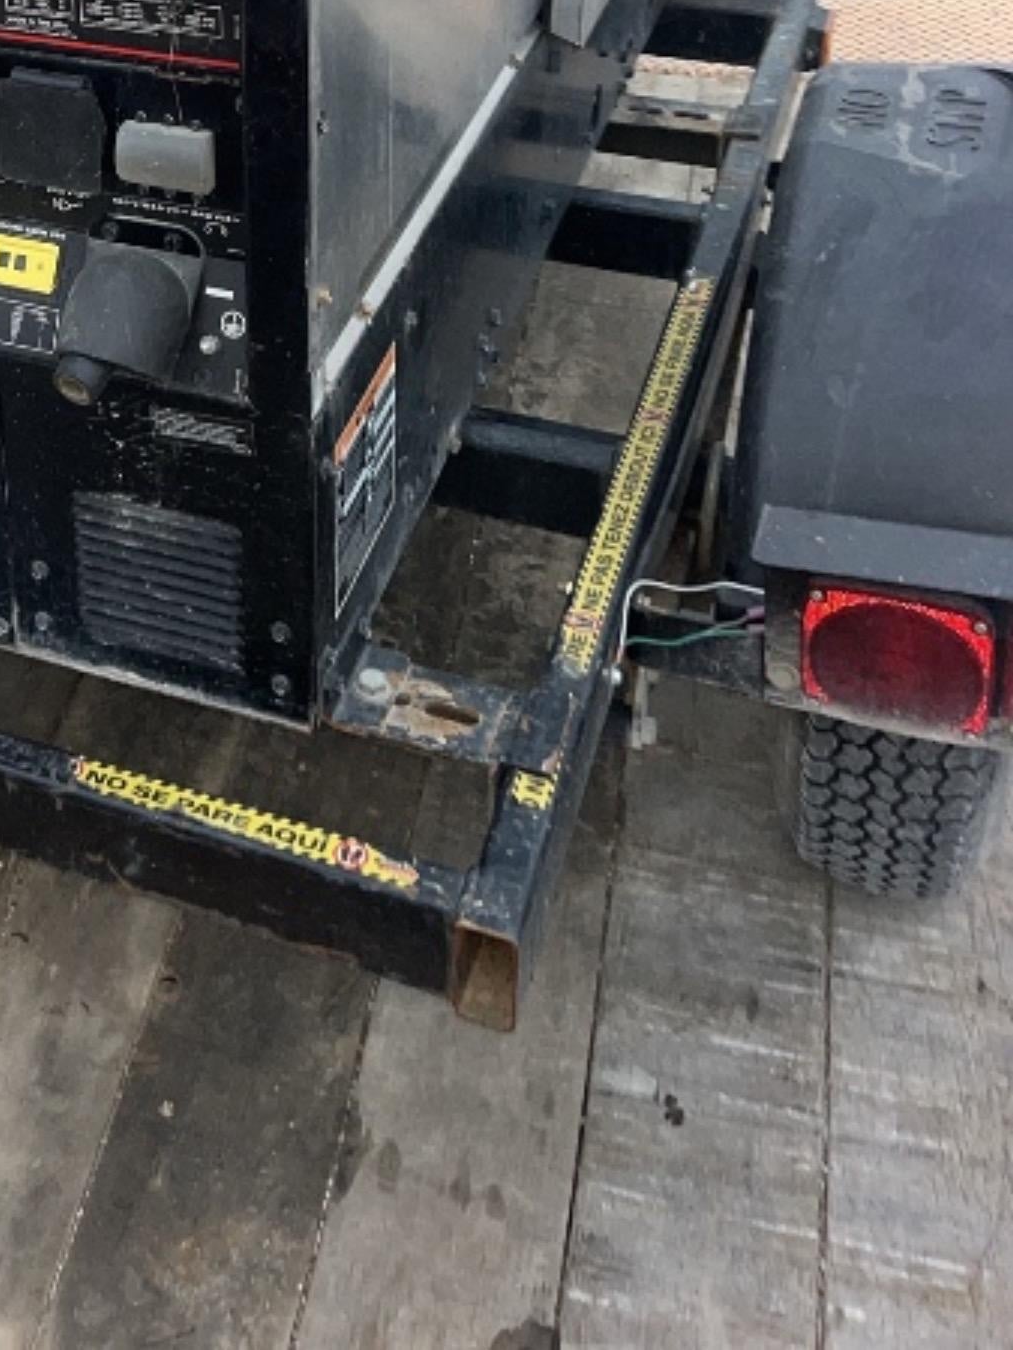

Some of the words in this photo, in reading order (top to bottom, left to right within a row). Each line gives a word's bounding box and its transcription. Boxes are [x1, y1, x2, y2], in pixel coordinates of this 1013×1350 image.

[590, 554, 614, 585] PAS
[602, 504, 630, 550] TENEZ
[85, 770, 127, 790] NO
[132, 784, 170, 804] SE
[177, 796, 249, 828] PARE
